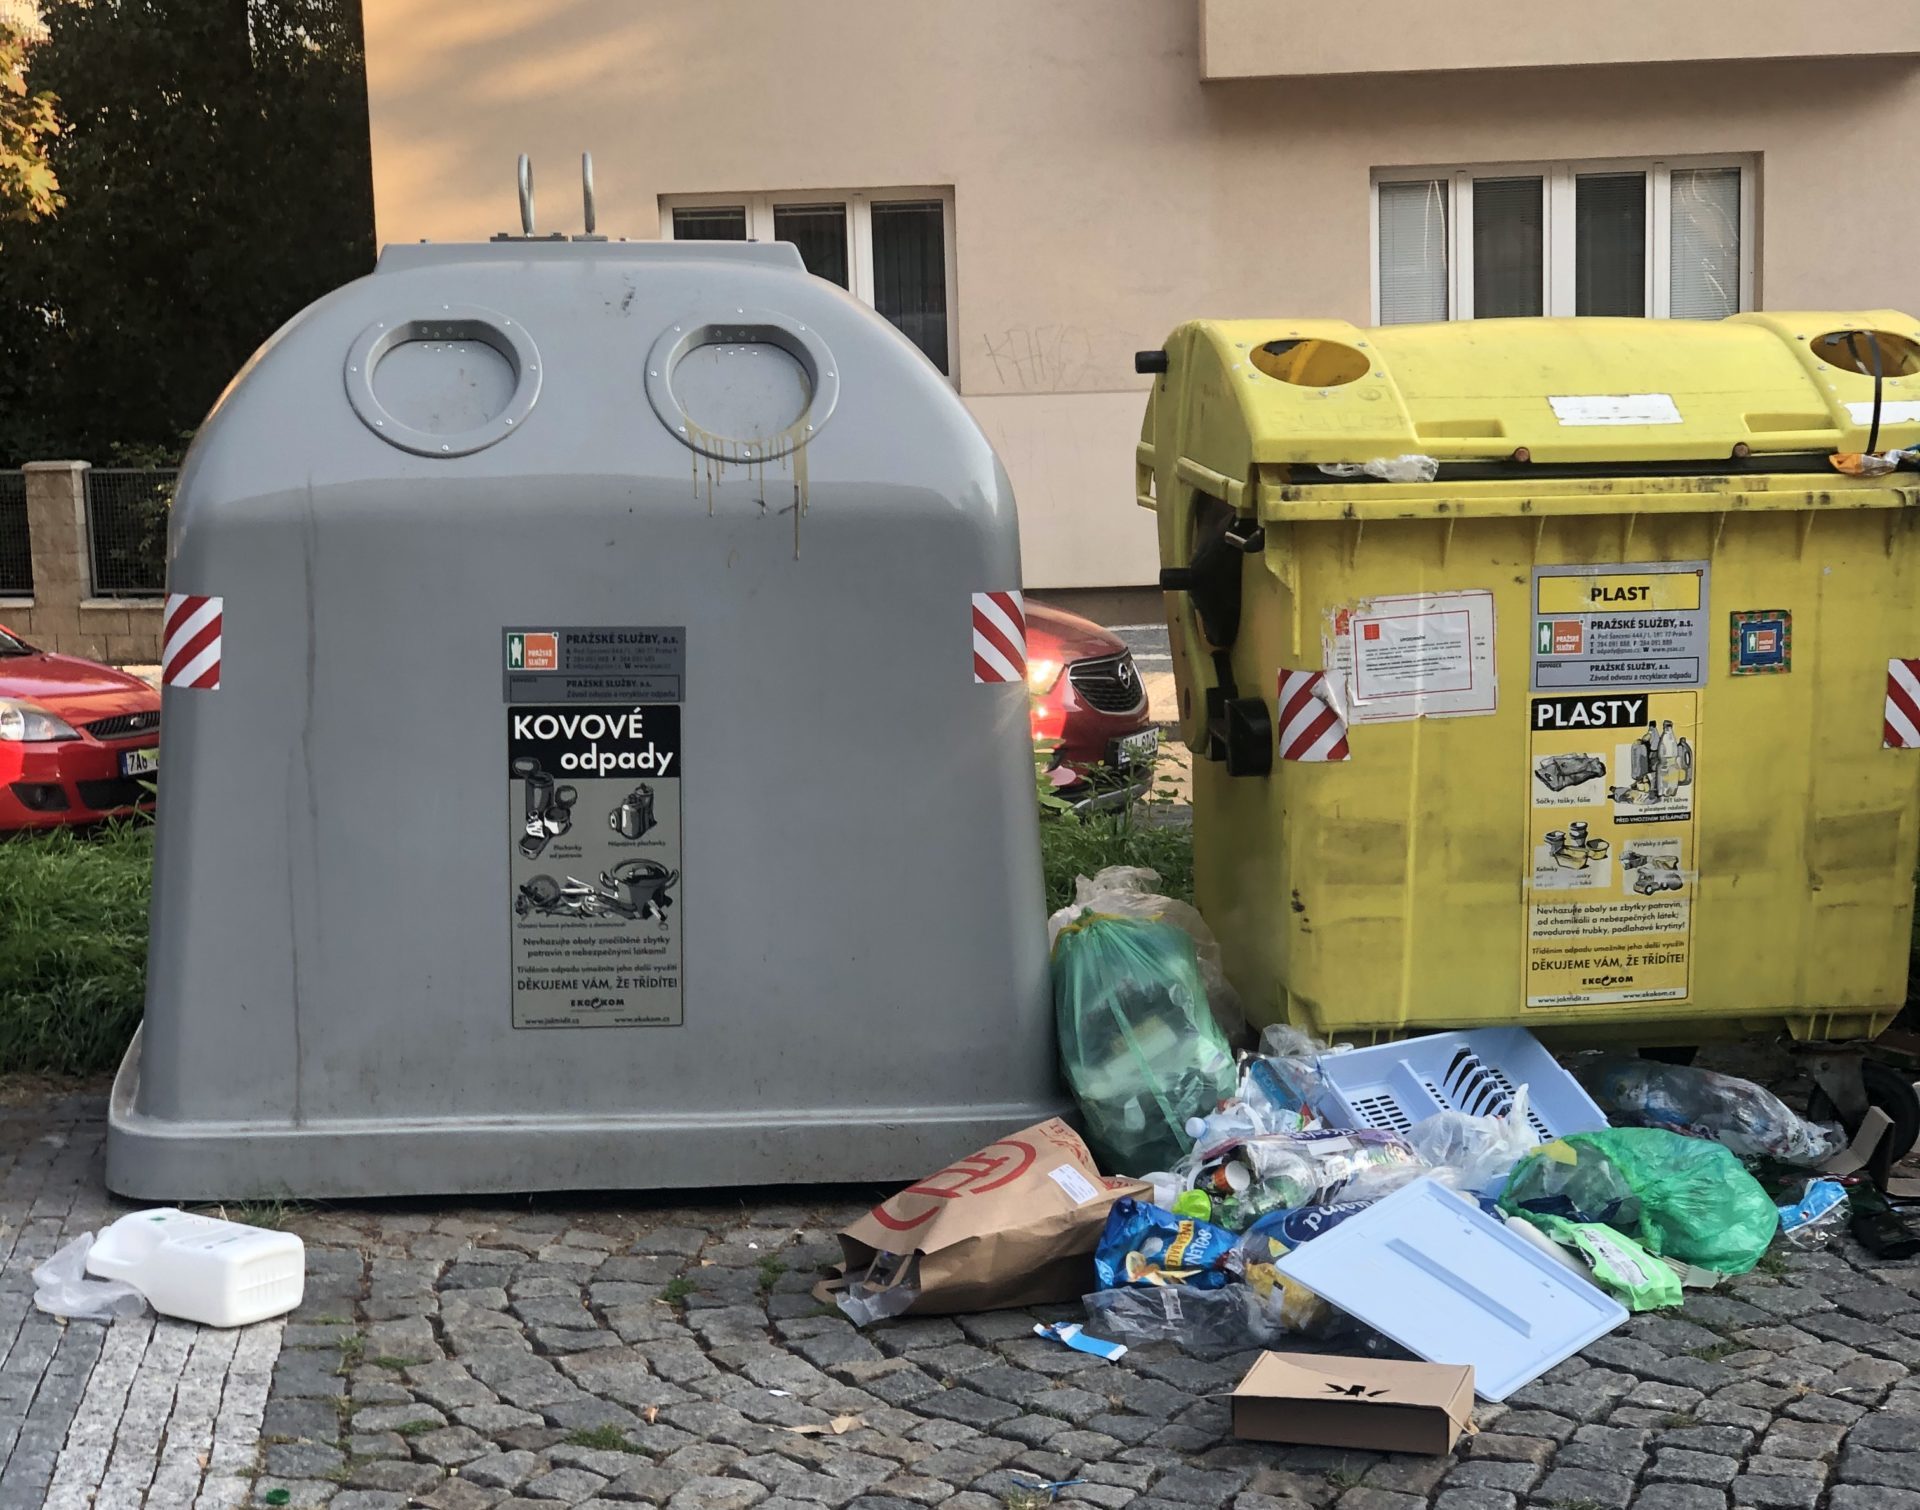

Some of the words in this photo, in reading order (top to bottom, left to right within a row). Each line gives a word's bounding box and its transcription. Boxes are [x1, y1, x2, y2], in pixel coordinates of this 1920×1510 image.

[1591, 587, 1649, 601] PLAST
[1591, 619, 1635, 629] PRAŽSKÉ
[1638, 617, 1677, 629] SLUŽBY,
[566, 633, 614, 644] PRAŽSKÉ
[1590, 662, 1625, 672] PRAŽSKÉ
[1538, 700, 1642, 727] PLASTY
[515, 707, 643, 740] KOVOVÉ
[561, 742, 673, 776] odpady
[1532, 957, 1590, 971] DĚKUJEME
[1594, 956, 1623, 969] VÁM,
[1626, 954, 1639, 966] ŽE
[1643, 953, 1684, 965] TŘÍDÍTE!
[518, 976, 579, 990] DĚKUJEME
[582, 976, 612, 990] VÁM,
[616, 975, 630, 989] ŽE
[1184, 1228, 1213, 1266] SOLEN
